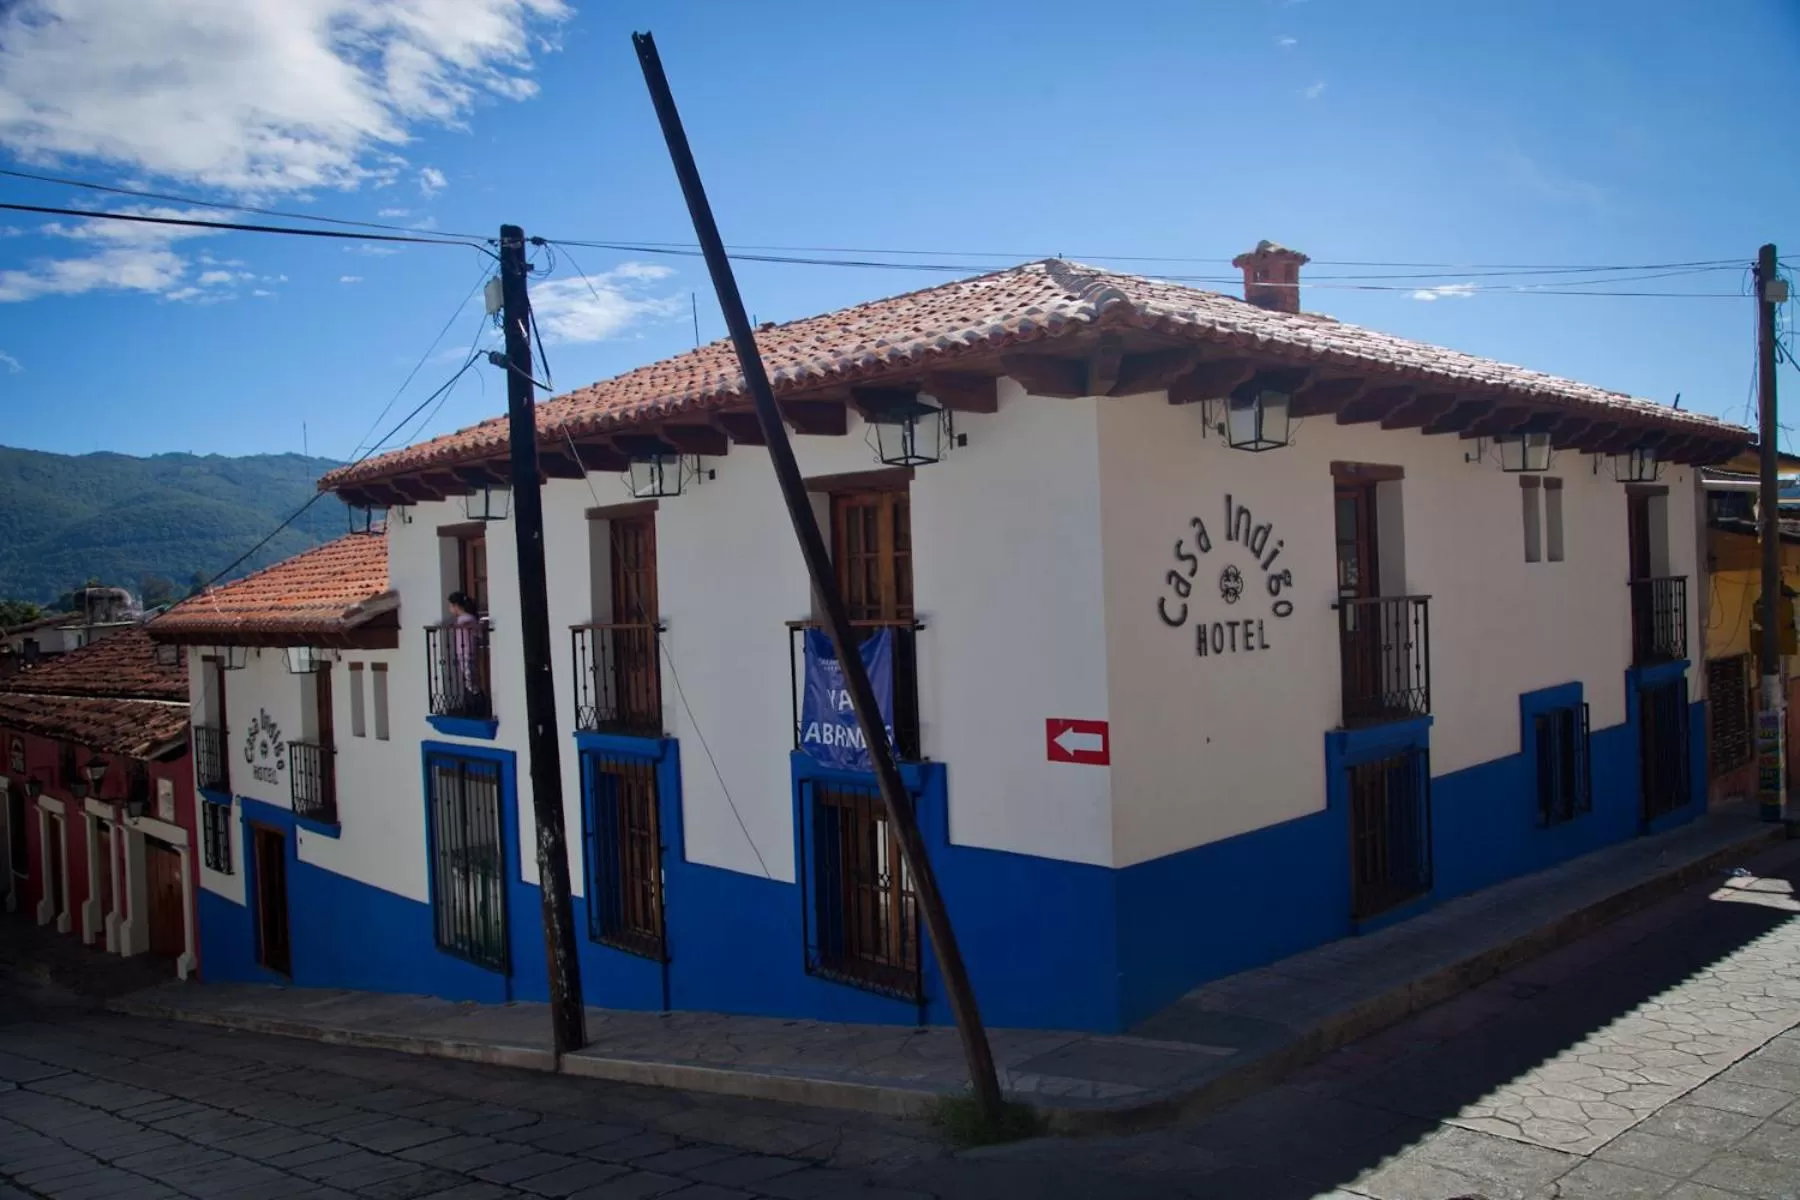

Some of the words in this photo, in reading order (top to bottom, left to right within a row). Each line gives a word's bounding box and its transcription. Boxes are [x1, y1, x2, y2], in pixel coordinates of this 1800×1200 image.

[1158, 516, 1212, 628] Casa
[1224, 493, 1294, 618] Indigo
[1195, 618, 1271, 657] HOTEL
[827, 688, 855, 712] YA
